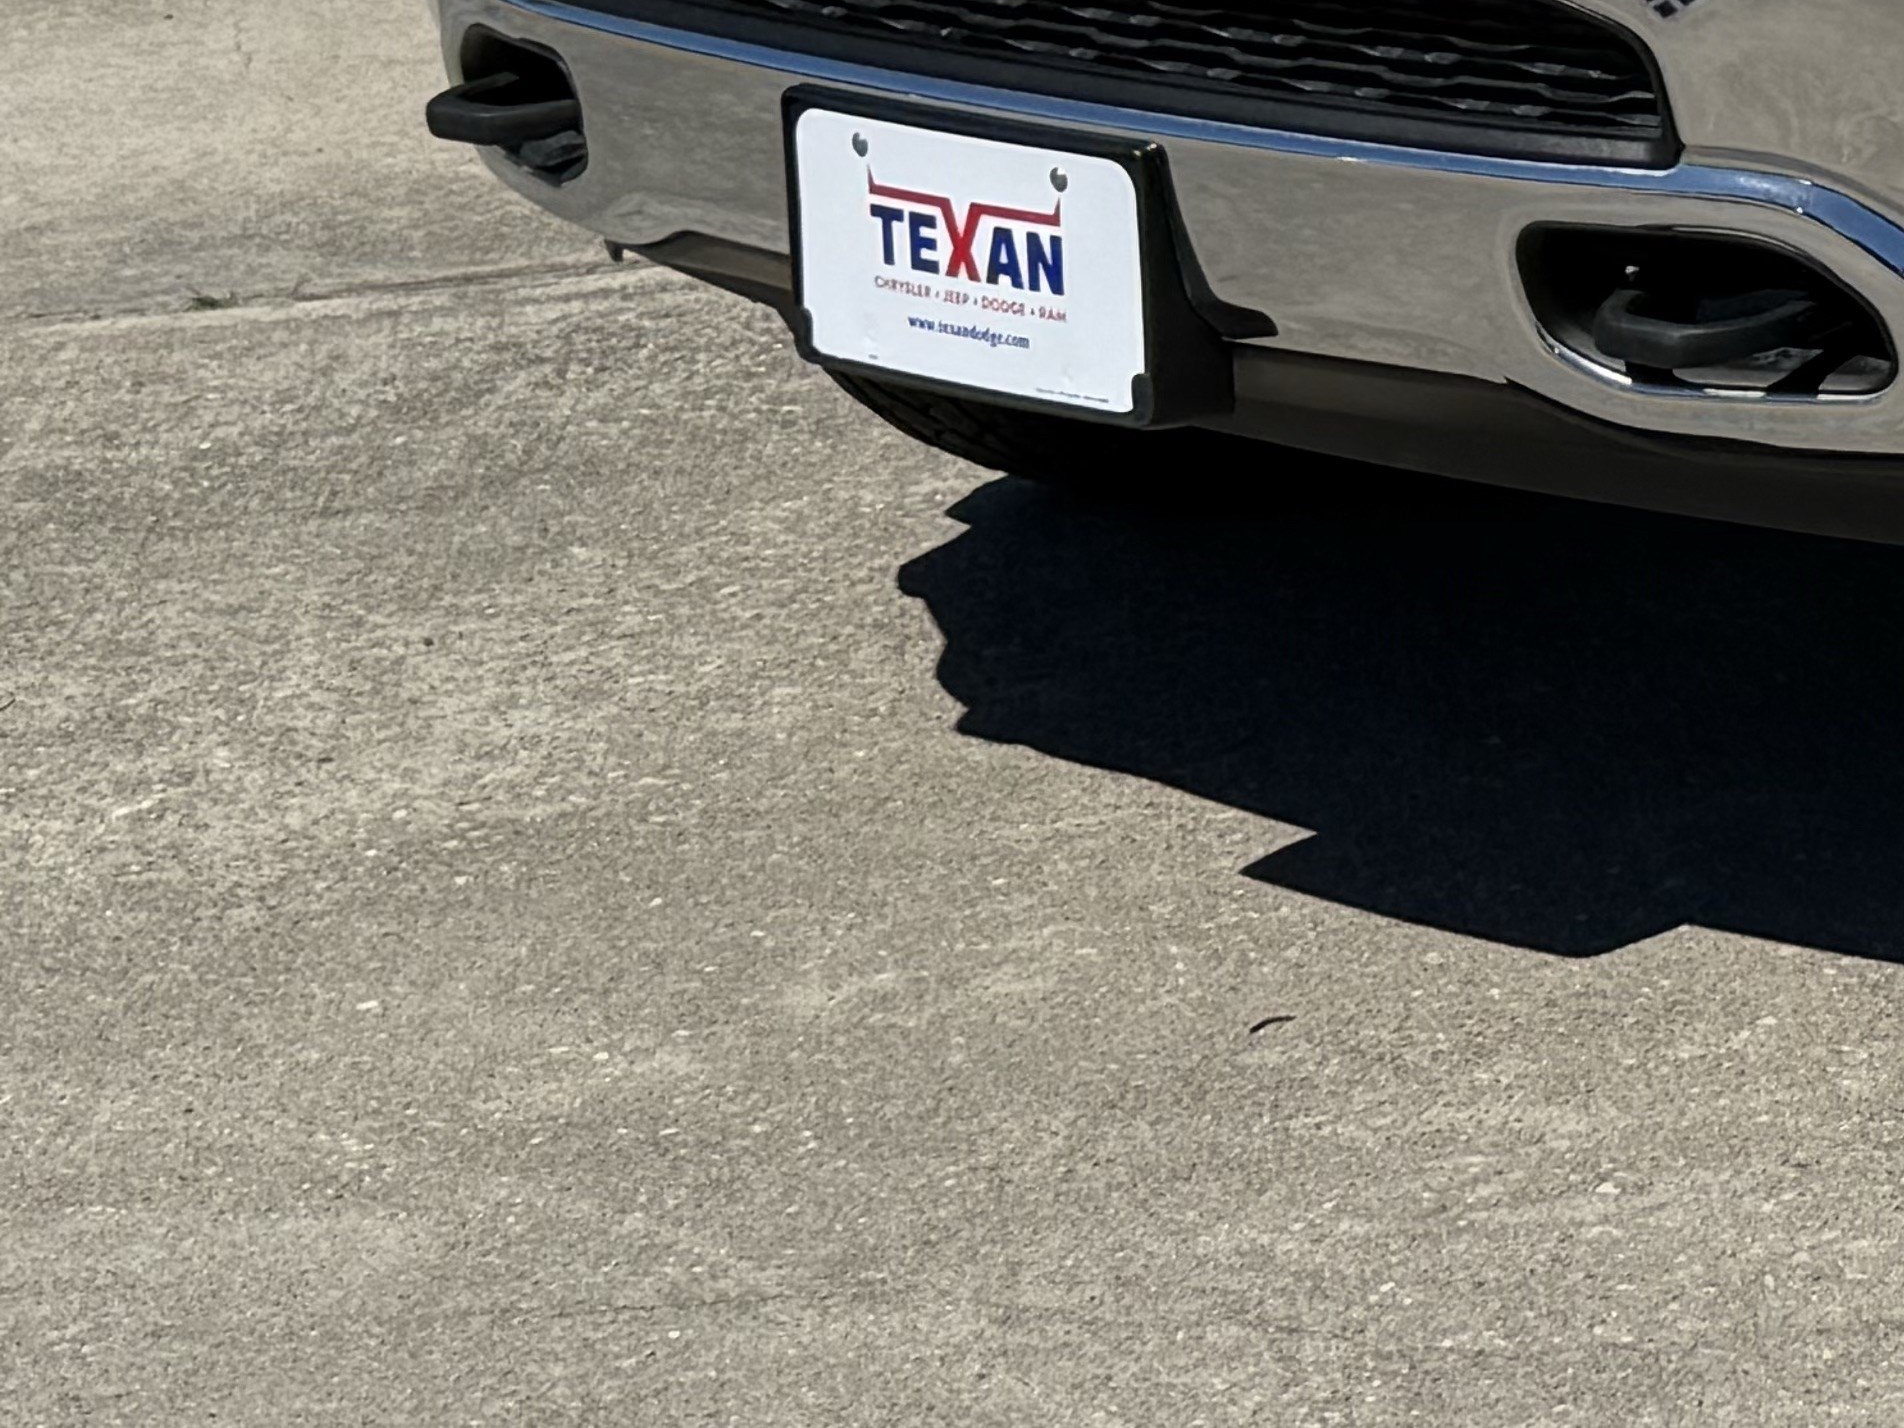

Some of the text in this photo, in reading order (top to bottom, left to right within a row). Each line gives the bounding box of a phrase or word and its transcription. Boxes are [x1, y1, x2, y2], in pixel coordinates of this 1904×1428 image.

[867, 164, 1065, 296] TEXAN
[874, 275, 1067, 323] CHRYSLER JEEP DODGE RAM
[908, 316, 1030, 348] www.texandodge.com
